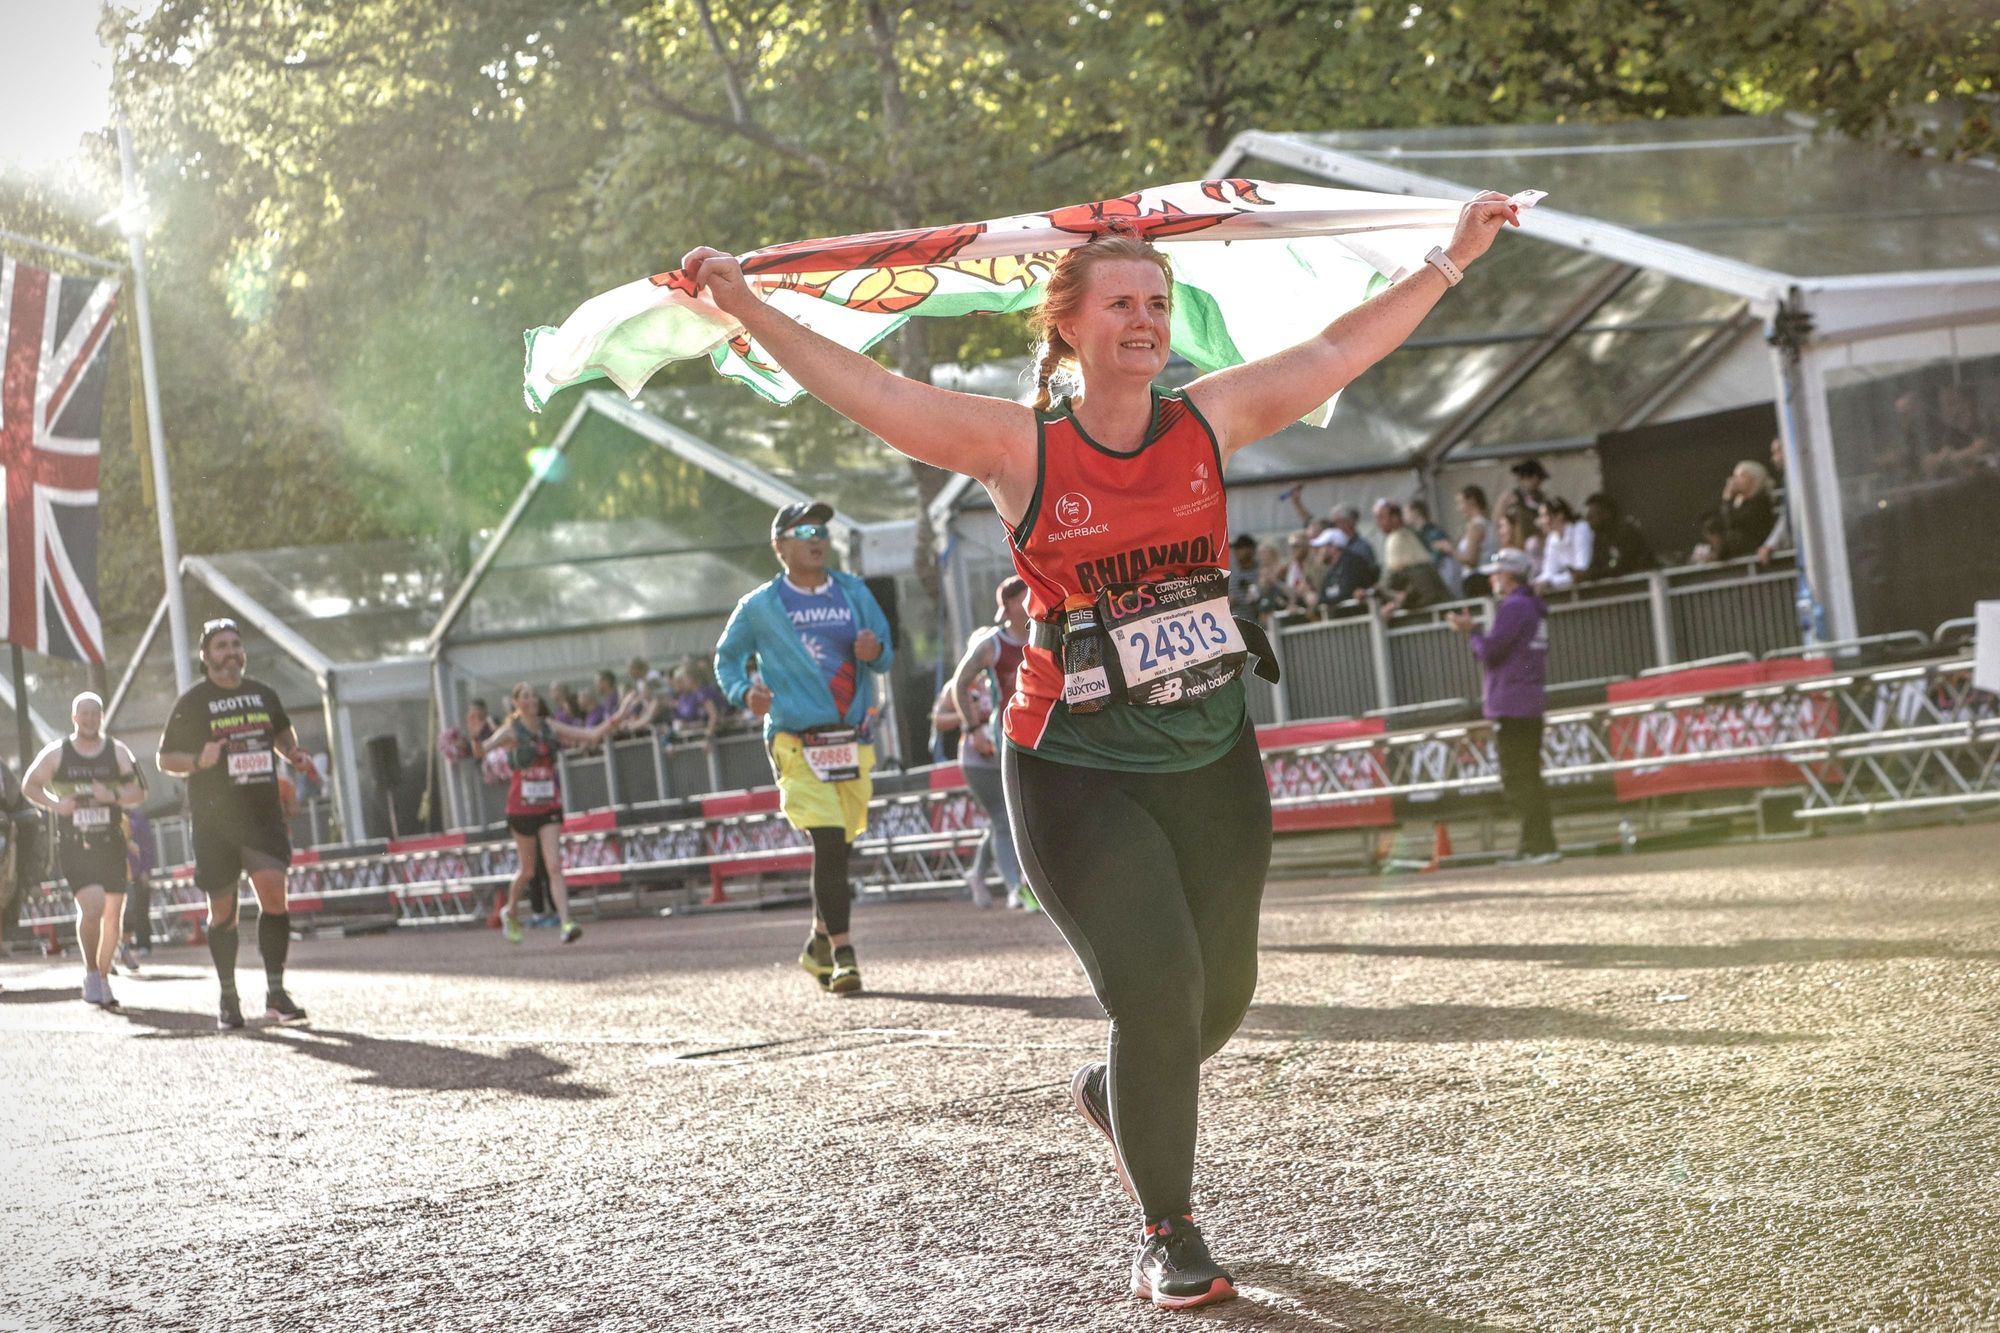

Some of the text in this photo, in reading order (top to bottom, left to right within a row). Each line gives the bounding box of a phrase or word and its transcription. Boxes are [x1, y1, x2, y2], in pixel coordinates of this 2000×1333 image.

[1048, 523, 1109, 543] SILVERBACK
[1159, 588, 1198, 605] SERVICES
[1130, 612, 1227, 672] 24313
[1067, 679, 1106, 697] BUXTON
[1186, 683, 1207, 697] new
[208, 694, 264, 714] SCOTTIE
